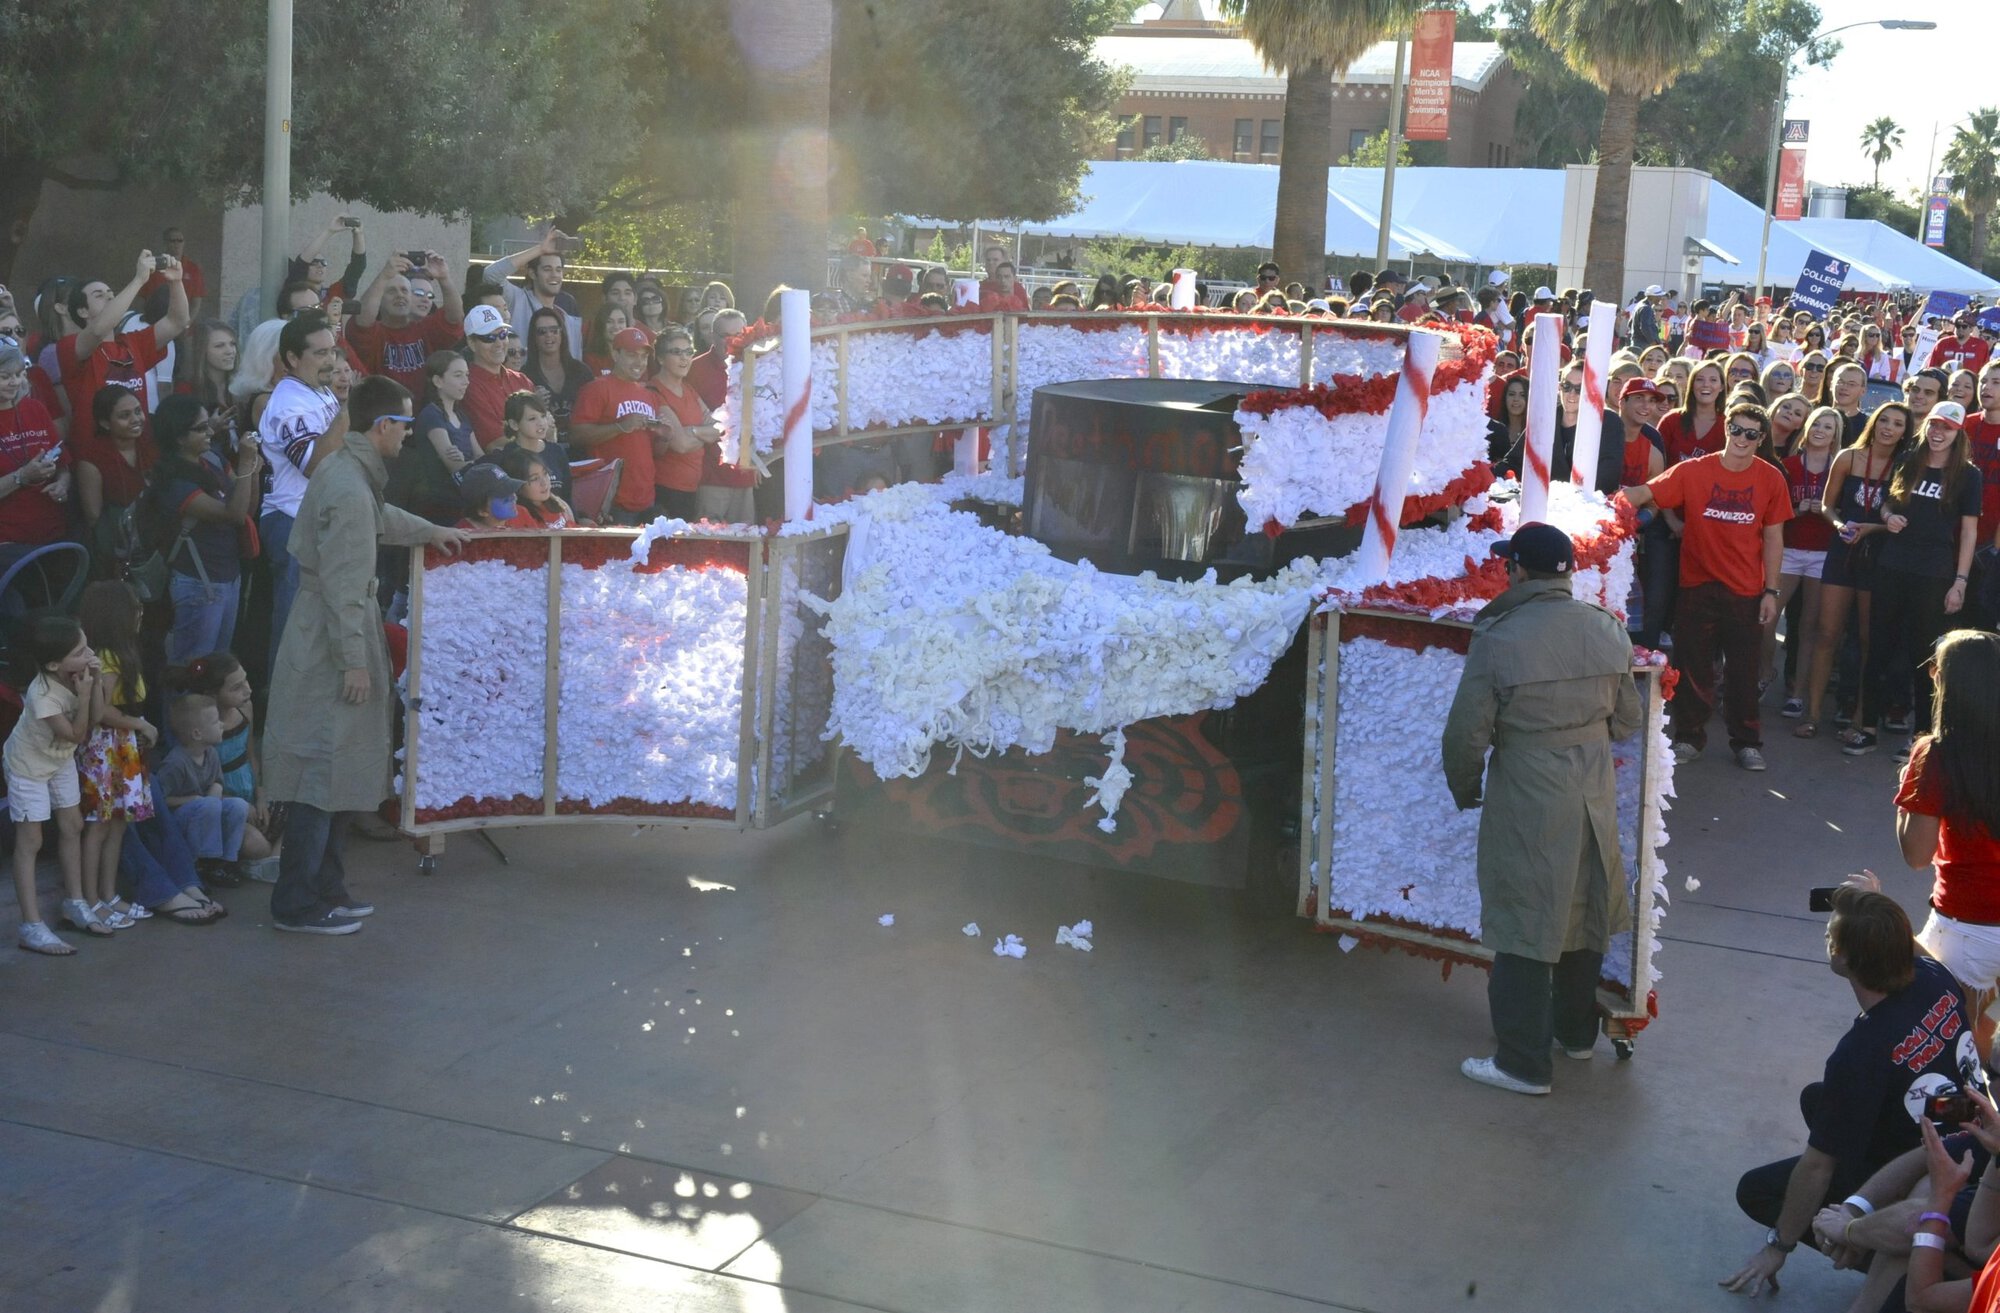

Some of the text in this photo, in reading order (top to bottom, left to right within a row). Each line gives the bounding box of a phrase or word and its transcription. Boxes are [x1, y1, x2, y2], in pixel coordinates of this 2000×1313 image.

[1420, 68, 1440, 77] NCAA
[1411, 79, 1449, 87] Champions
[1415, 88, 1443, 96] Men's &
[1412, 97, 1445, 105] Women's
[1409, 106, 1448, 116] Swimming
[1802, 267, 1844, 289] COLLEGE
[1810, 284, 1825, 295] OF
[1790, 291, 1834, 313] PHARMACY
[616, 400, 656, 421] ARIZON
[281, 416, 309, 442] 44
[1920, 990, 1959, 1033] KAPPA
